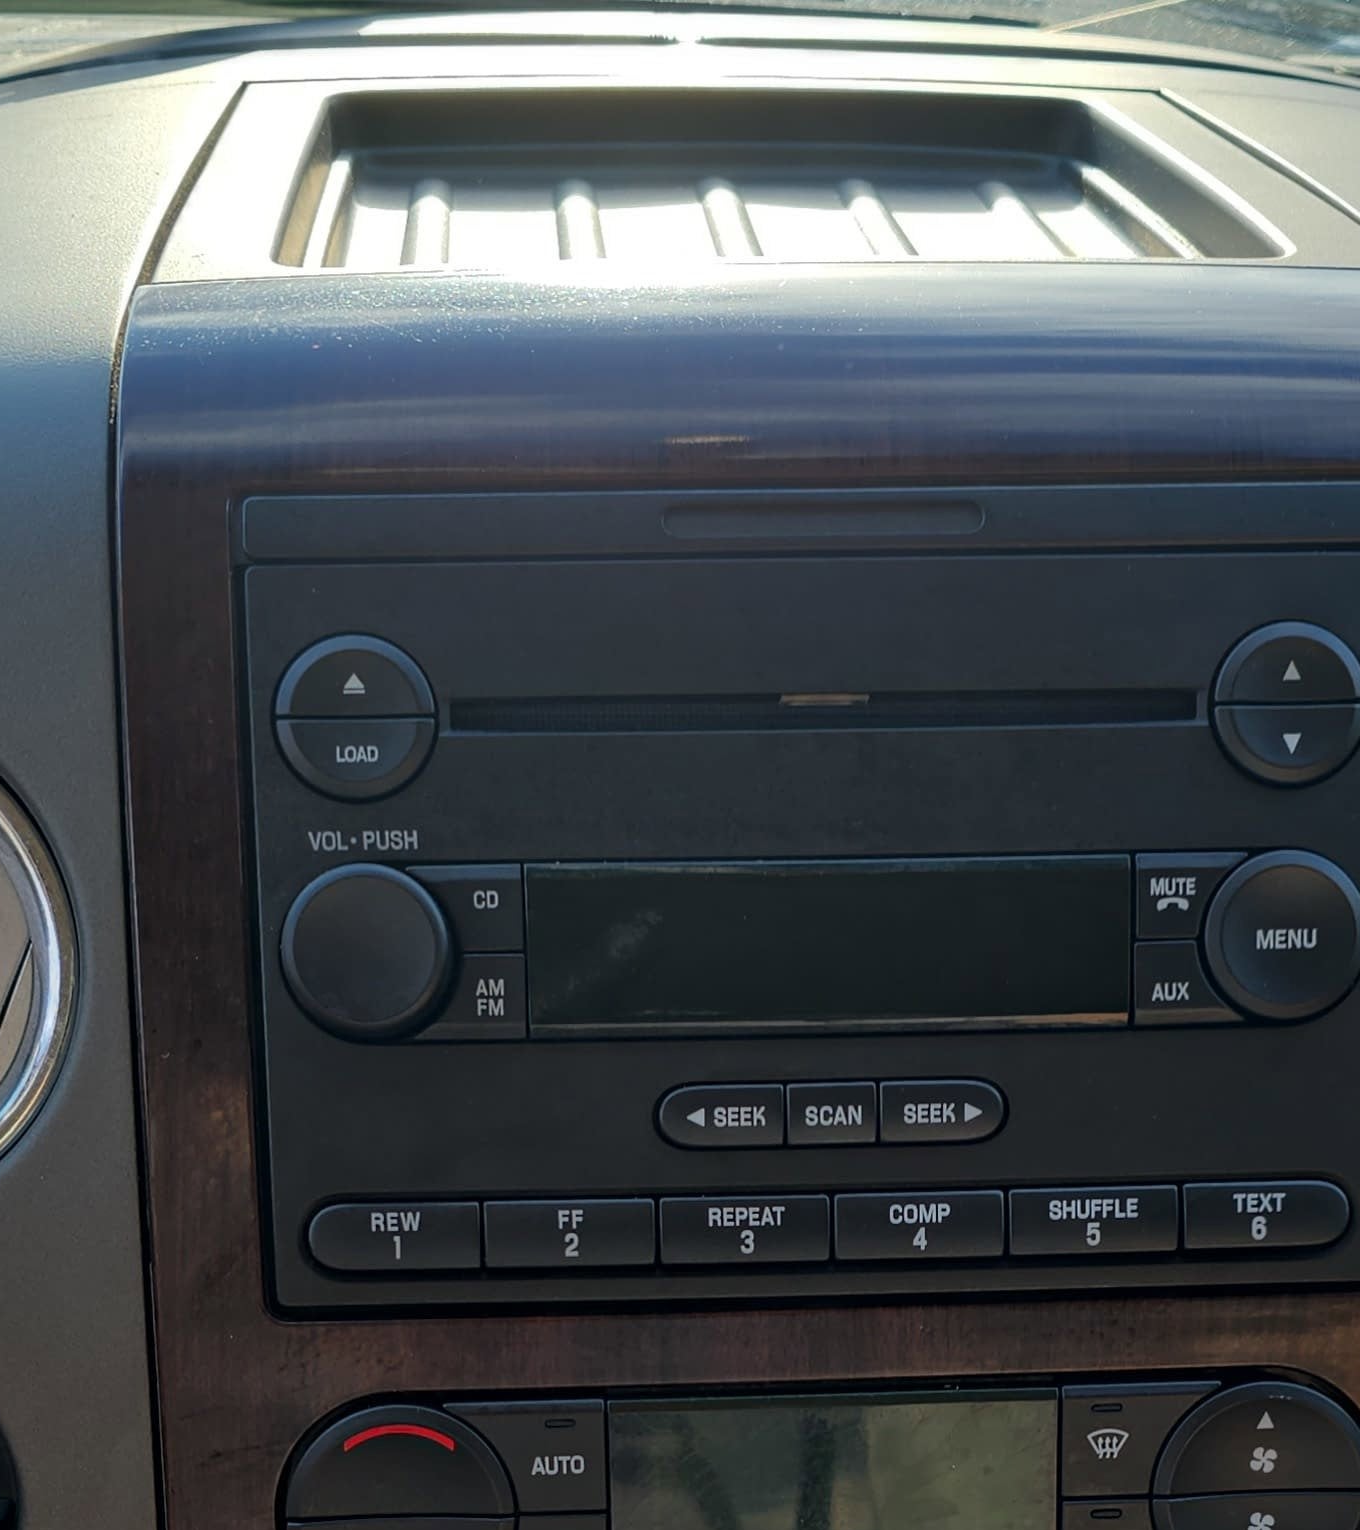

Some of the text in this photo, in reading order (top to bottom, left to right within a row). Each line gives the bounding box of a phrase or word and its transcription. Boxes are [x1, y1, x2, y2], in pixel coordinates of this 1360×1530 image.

[335, 745, 379, 764] LOAD
[362, 830, 419, 851] PUSH
[1149, 877, 1197, 897] MUTE
[472, 891, 500, 911] CD
[1255, 928, 1318, 950] MENU
[475, 979, 505, 997] AM
[1151, 982, 1190, 1002] AUX
[476, 999, 505, 1017] FM
[712, 1106, 767, 1128] SEEK
[804, 1105, 863, 1126] SCAN
[903, 1103, 956, 1124] SEEK
[888, 1203, 951, 1224] COMP
[1048, 1198, 1139, 1220] SHUFFLE
[1233, 1192, 1286, 1214] TEXT
[370, 1211, 422, 1233] REW
[557, 1209, 585, 1230] FF
[708, 1206, 786, 1228] REPEAT
[911, 1227, 928, 1251] 4
[1085, 1222, 1101, 1247] 5
[1251, 1216, 1268, 1241] 6
[392, 1236, 402, 1260] 1
[564, 1233, 580, 1257] 2
[739, 1230, 756, 1255] 3
[531, 1455, 586, 1476] AUTO
